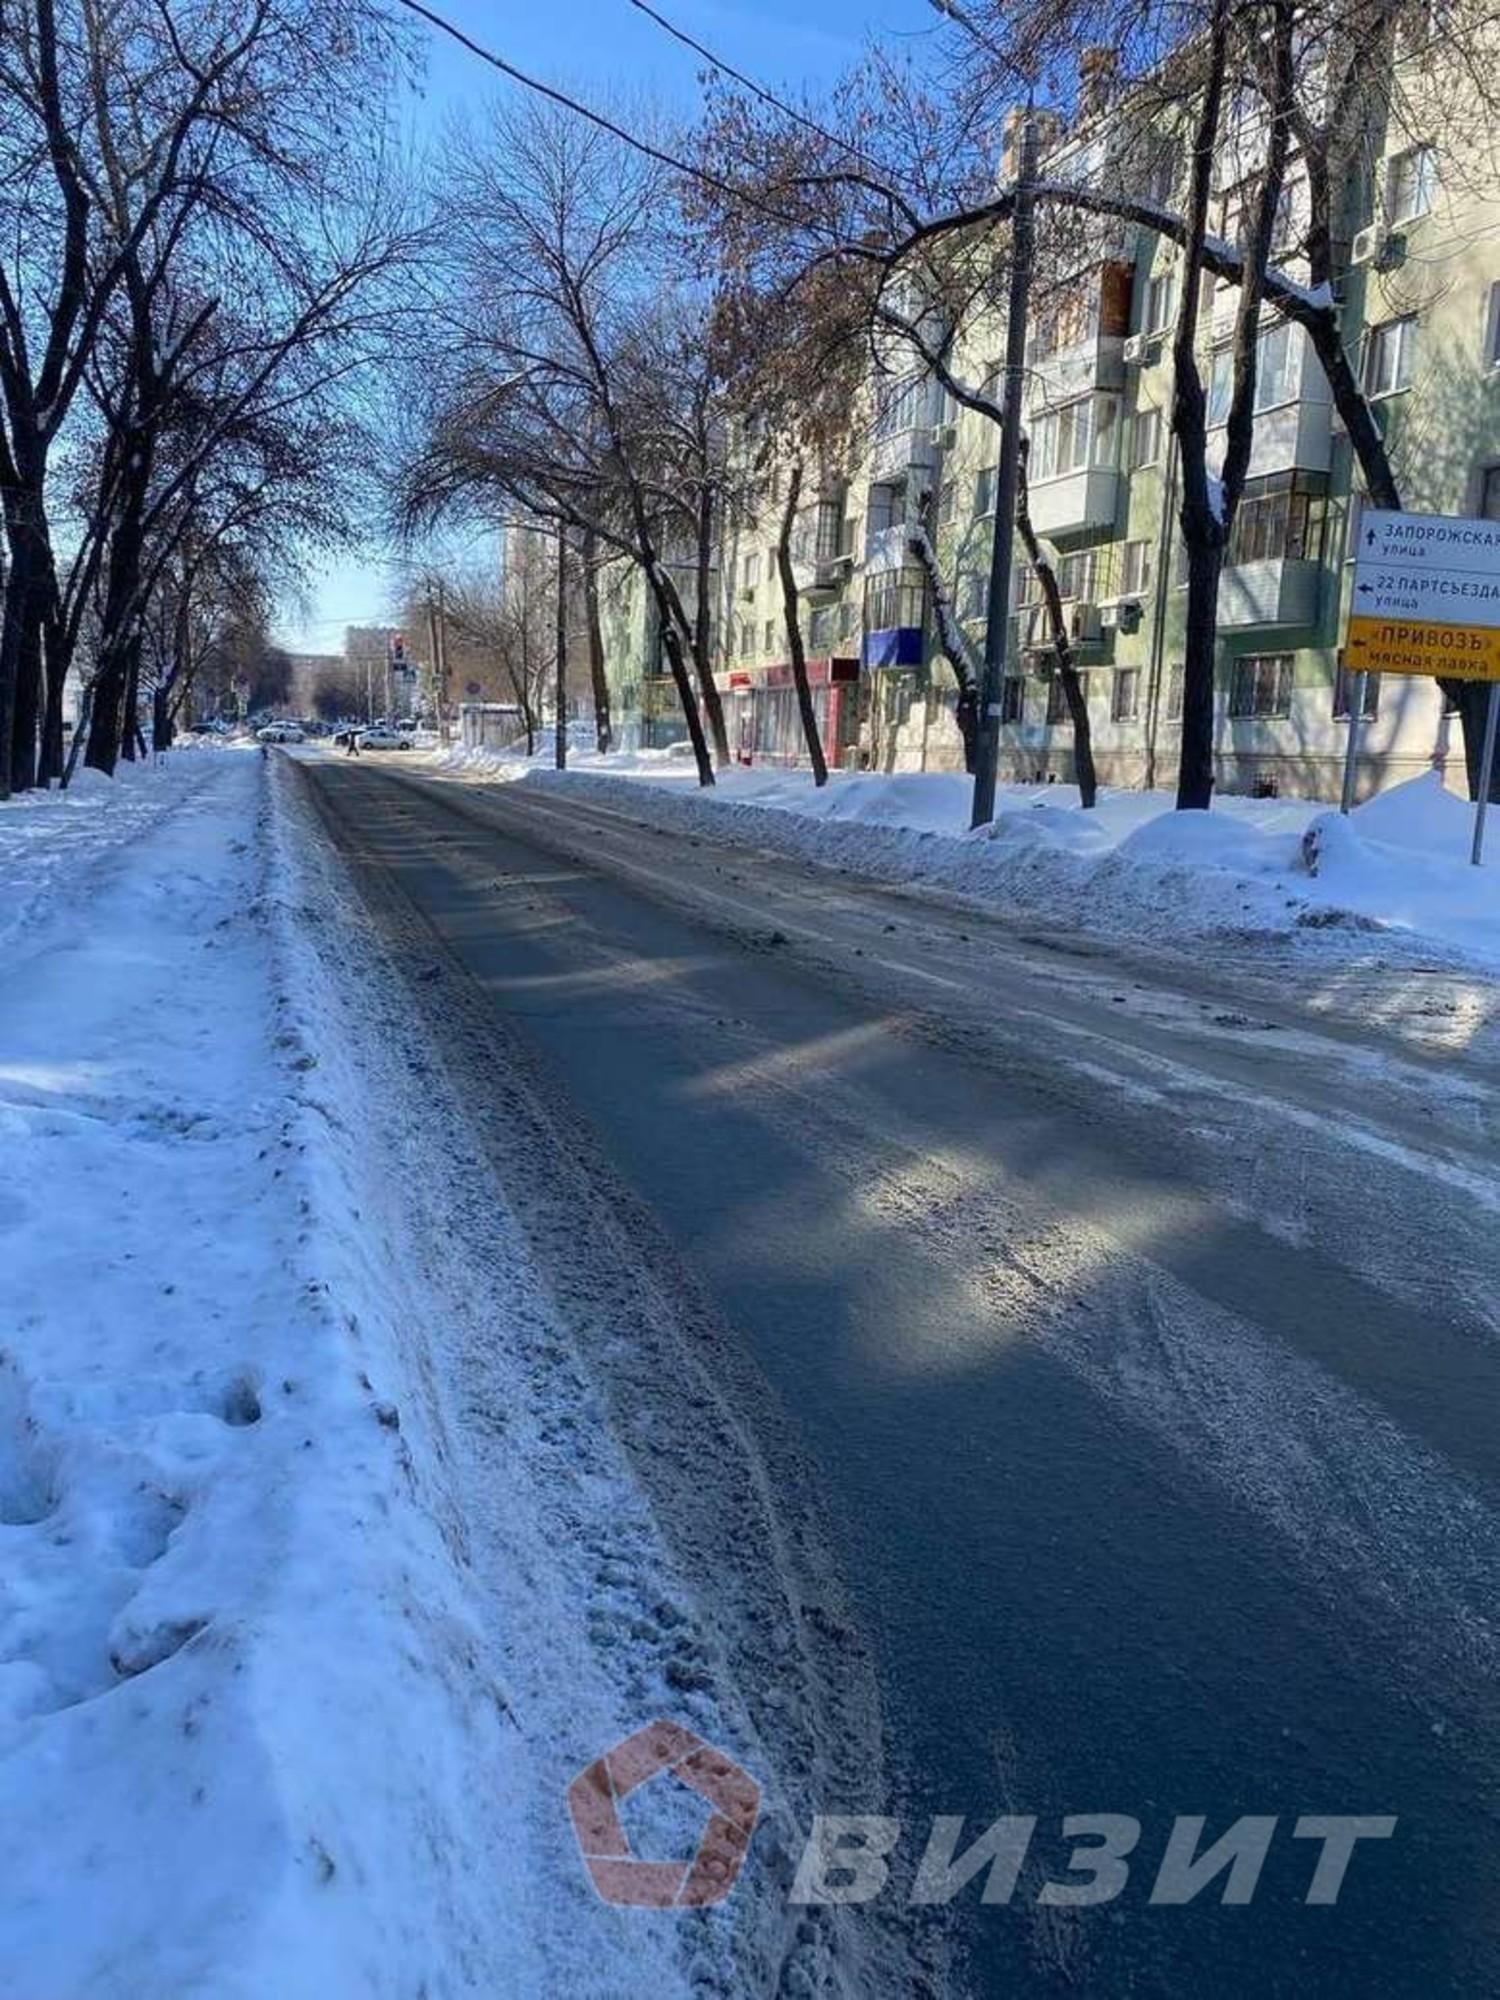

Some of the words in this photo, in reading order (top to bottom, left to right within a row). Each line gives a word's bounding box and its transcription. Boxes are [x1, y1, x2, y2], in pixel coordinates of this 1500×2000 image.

[1382, 543, 1425, 556] улица
[1377, 575, 1394, 589] 22
[1375, 595, 1419, 609] улица
